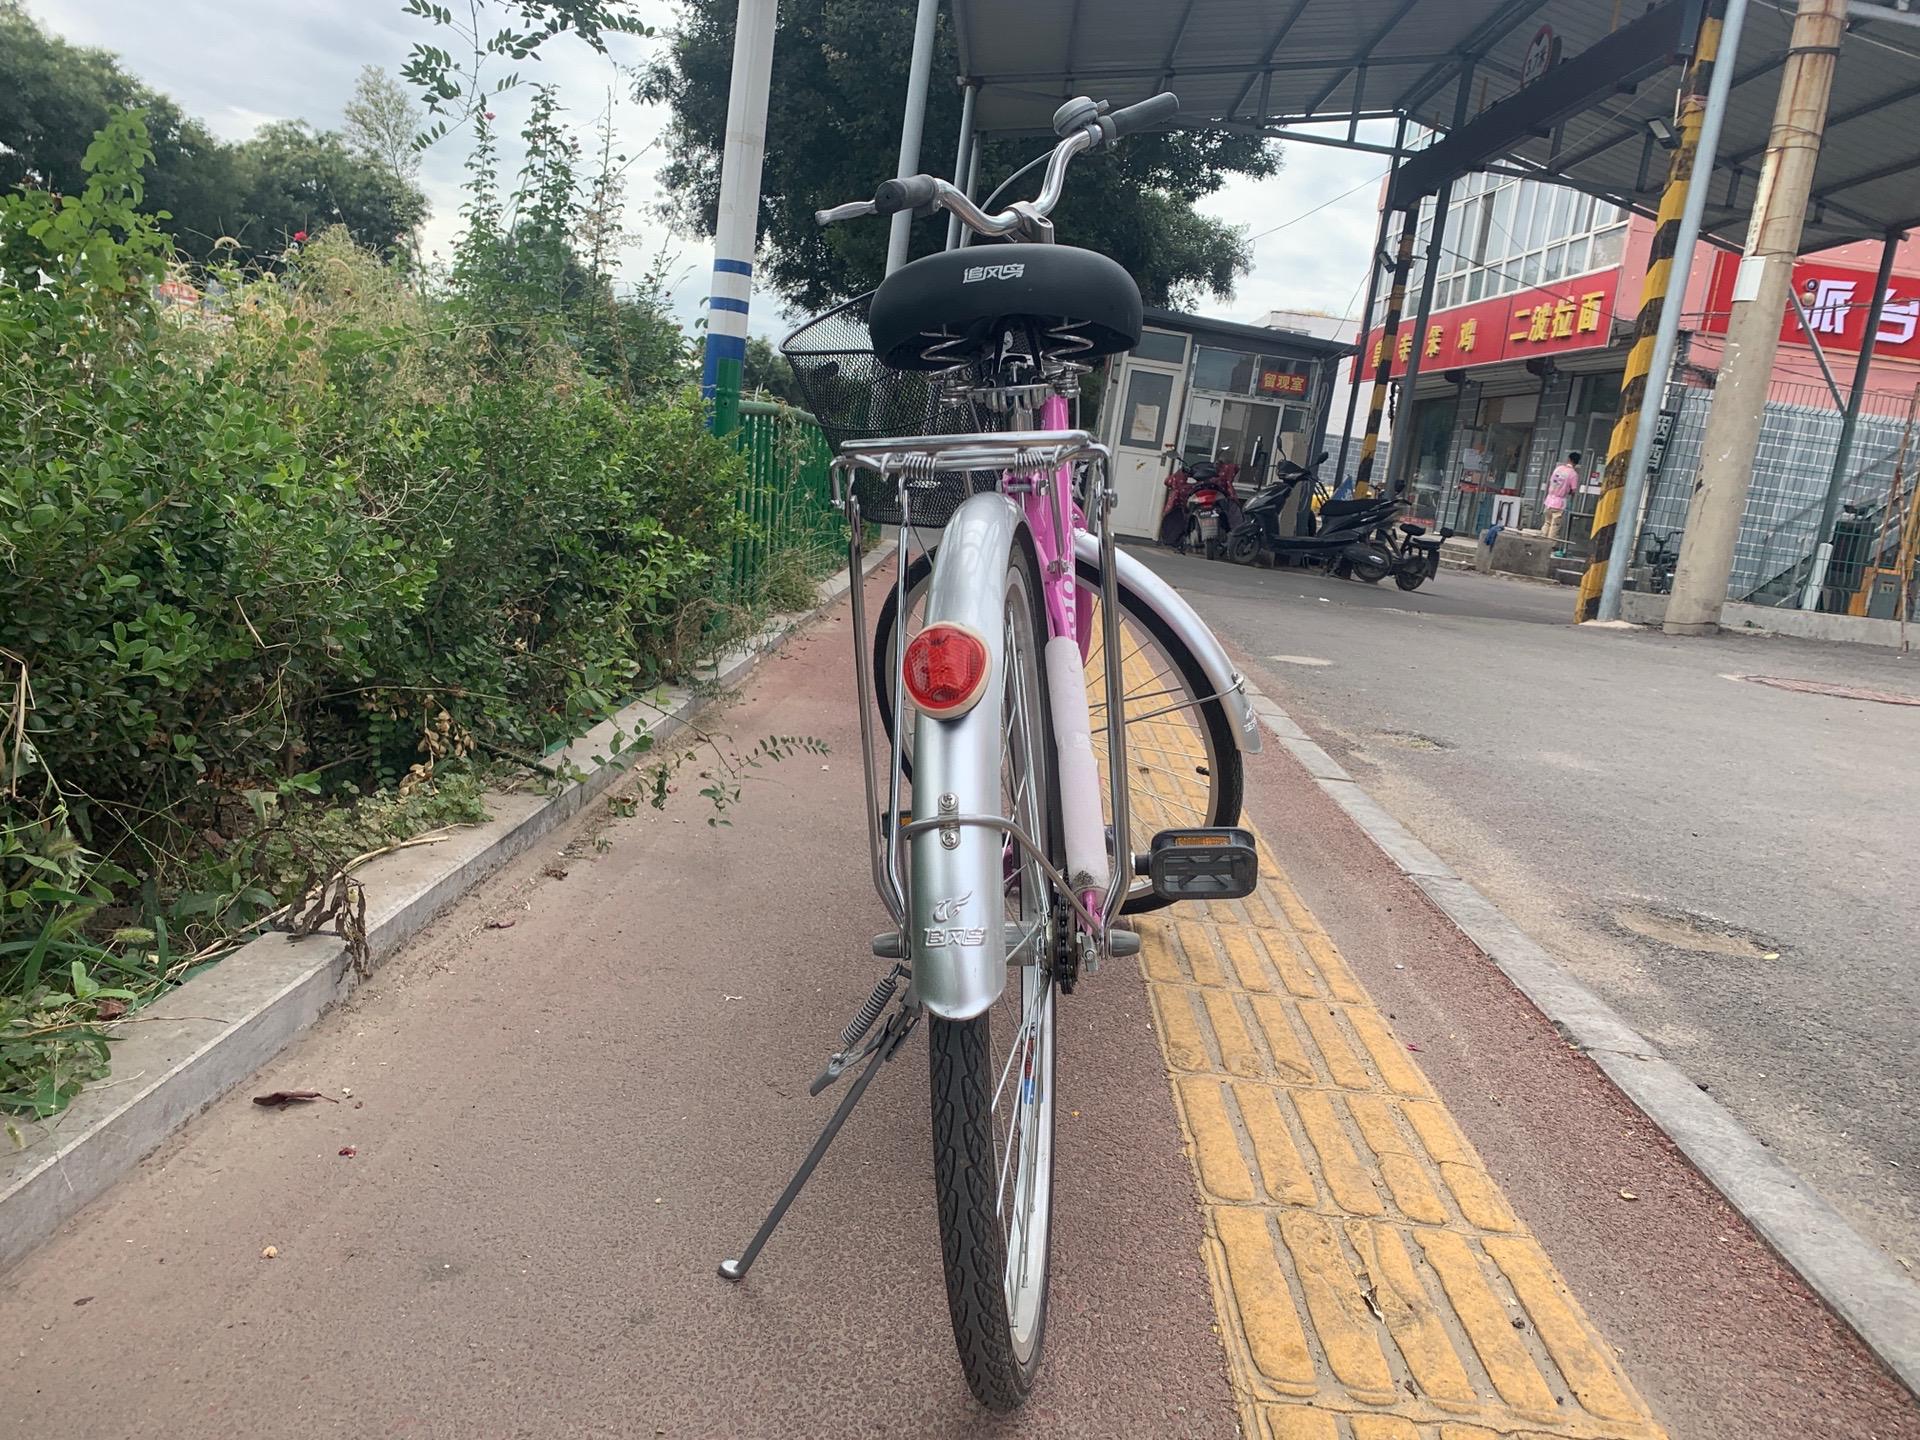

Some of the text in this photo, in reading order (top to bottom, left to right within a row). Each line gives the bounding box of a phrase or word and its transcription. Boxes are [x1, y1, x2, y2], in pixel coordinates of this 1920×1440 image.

[962, 263, 1025, 284] 追风鸟
[1264, 372, 1305, 392] 留观室
